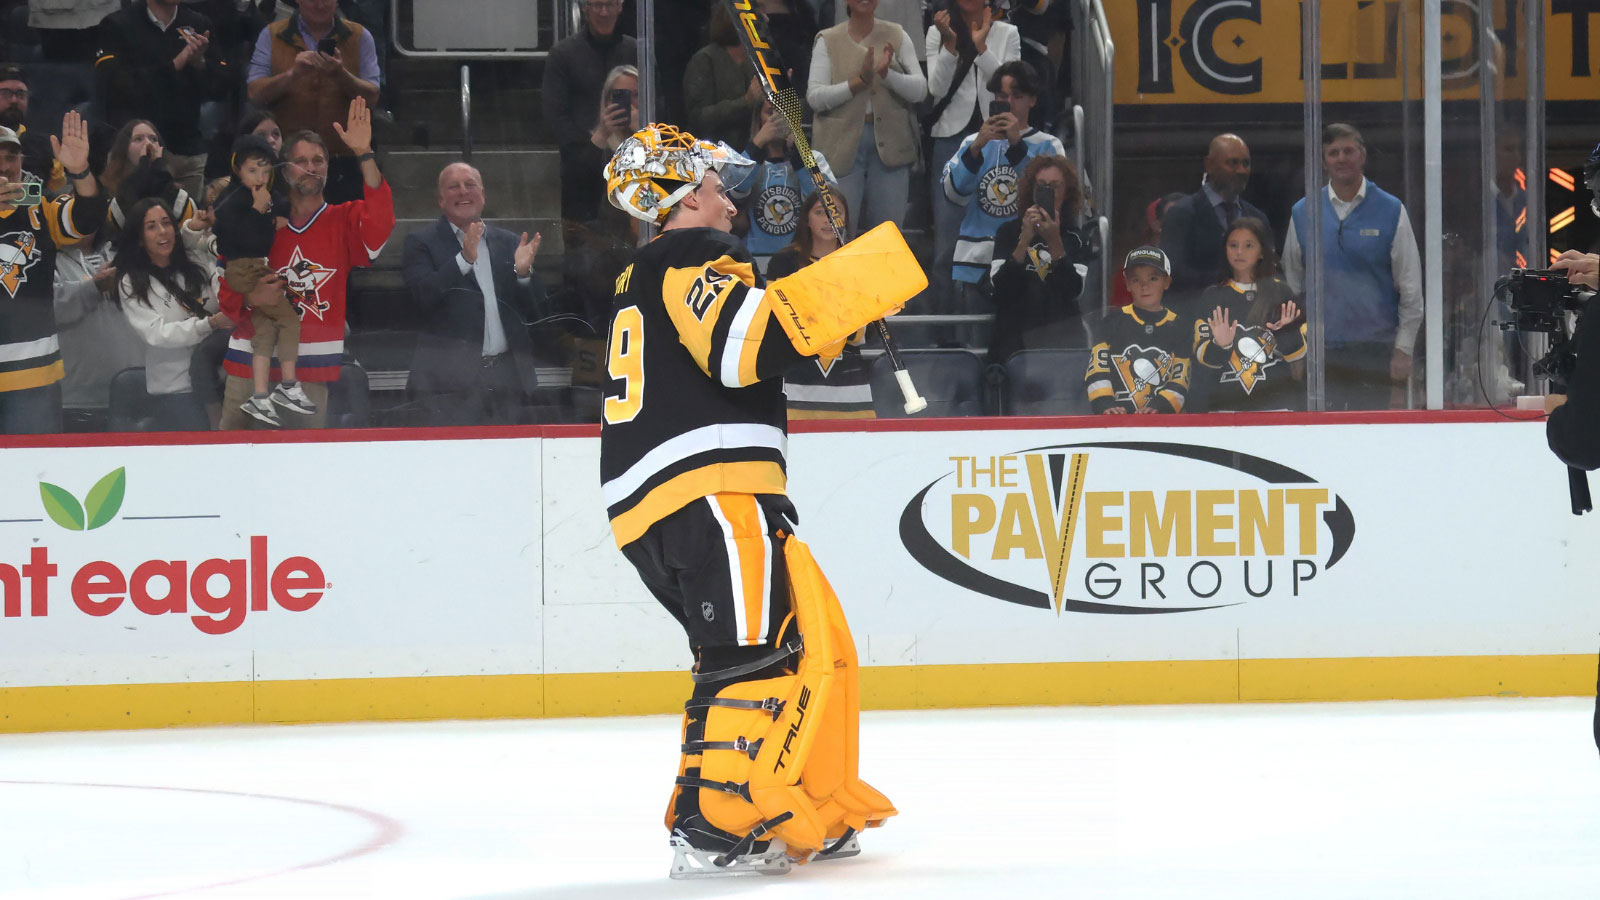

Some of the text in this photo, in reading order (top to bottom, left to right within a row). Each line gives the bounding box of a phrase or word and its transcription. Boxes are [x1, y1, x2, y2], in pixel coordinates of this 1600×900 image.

[1137, 0, 1262, 95] IC
[757, 215, 800, 234] PENGUINS
[775, 289, 811, 346] TRUE
[603, 305, 645, 426] 9
[949, 456, 1018, 488] THE
[951, 453, 1329, 618] PAVEMENT
[1085, 559, 1317, 600] GROUP
[71, 535, 326, 635] eagle
[774, 685, 811, 775] TRUE
